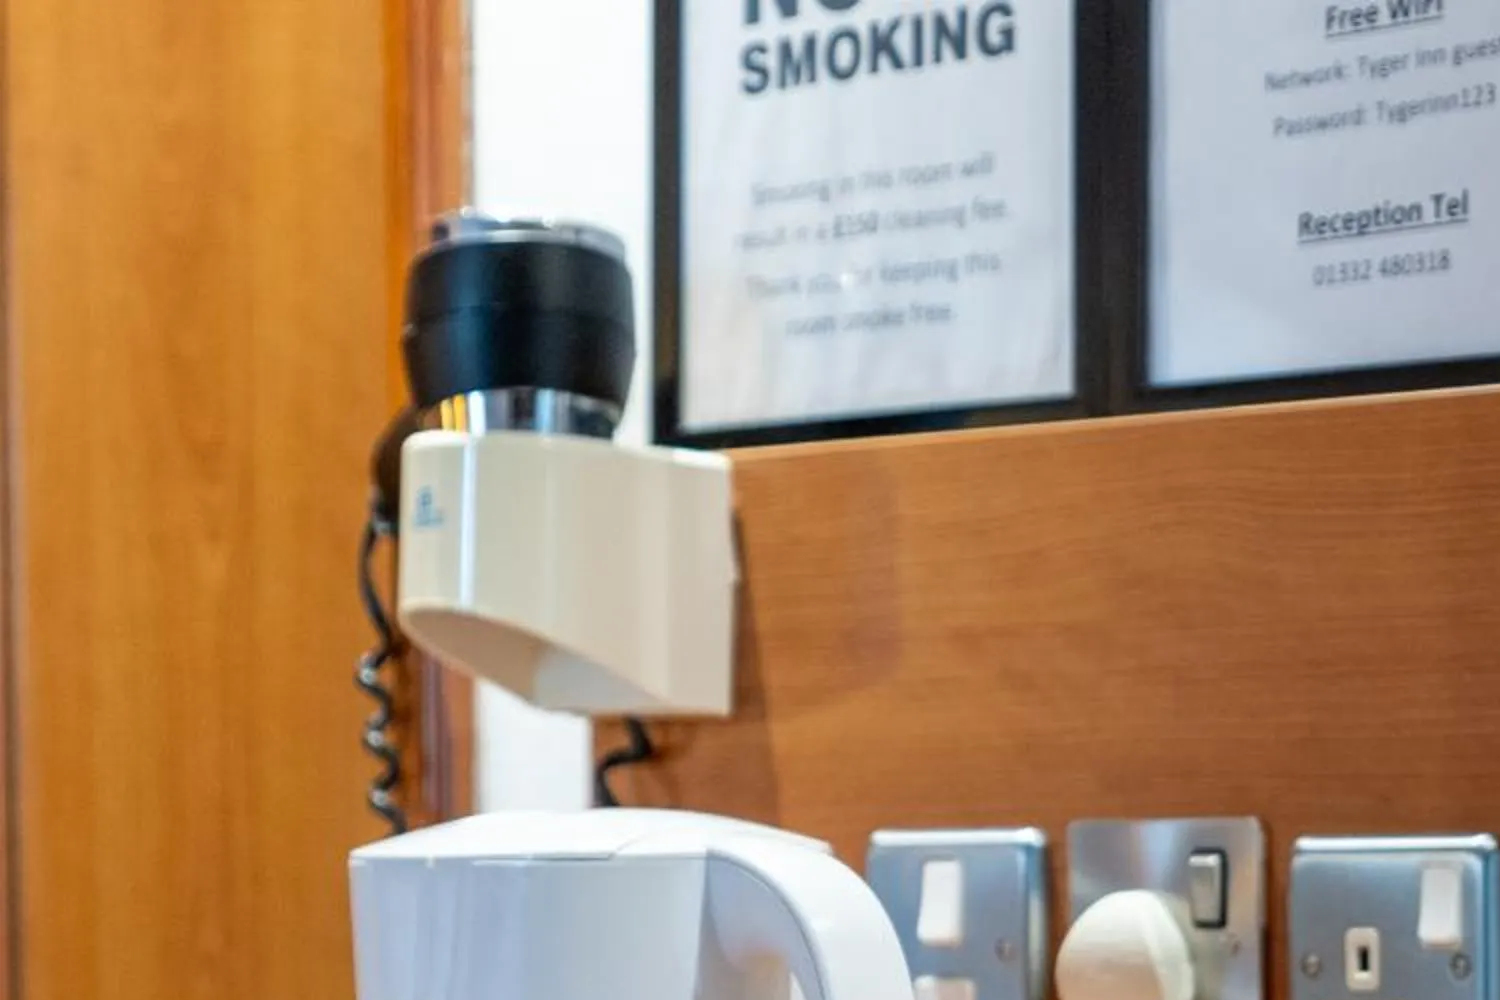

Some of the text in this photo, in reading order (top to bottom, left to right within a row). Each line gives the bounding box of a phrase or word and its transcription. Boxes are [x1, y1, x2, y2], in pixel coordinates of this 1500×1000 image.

[1325, 5, 1379, 33] Free
[741, 1, 1017, 95] SMOKING
[1297, 188, 1470, 238] Reception Tel
